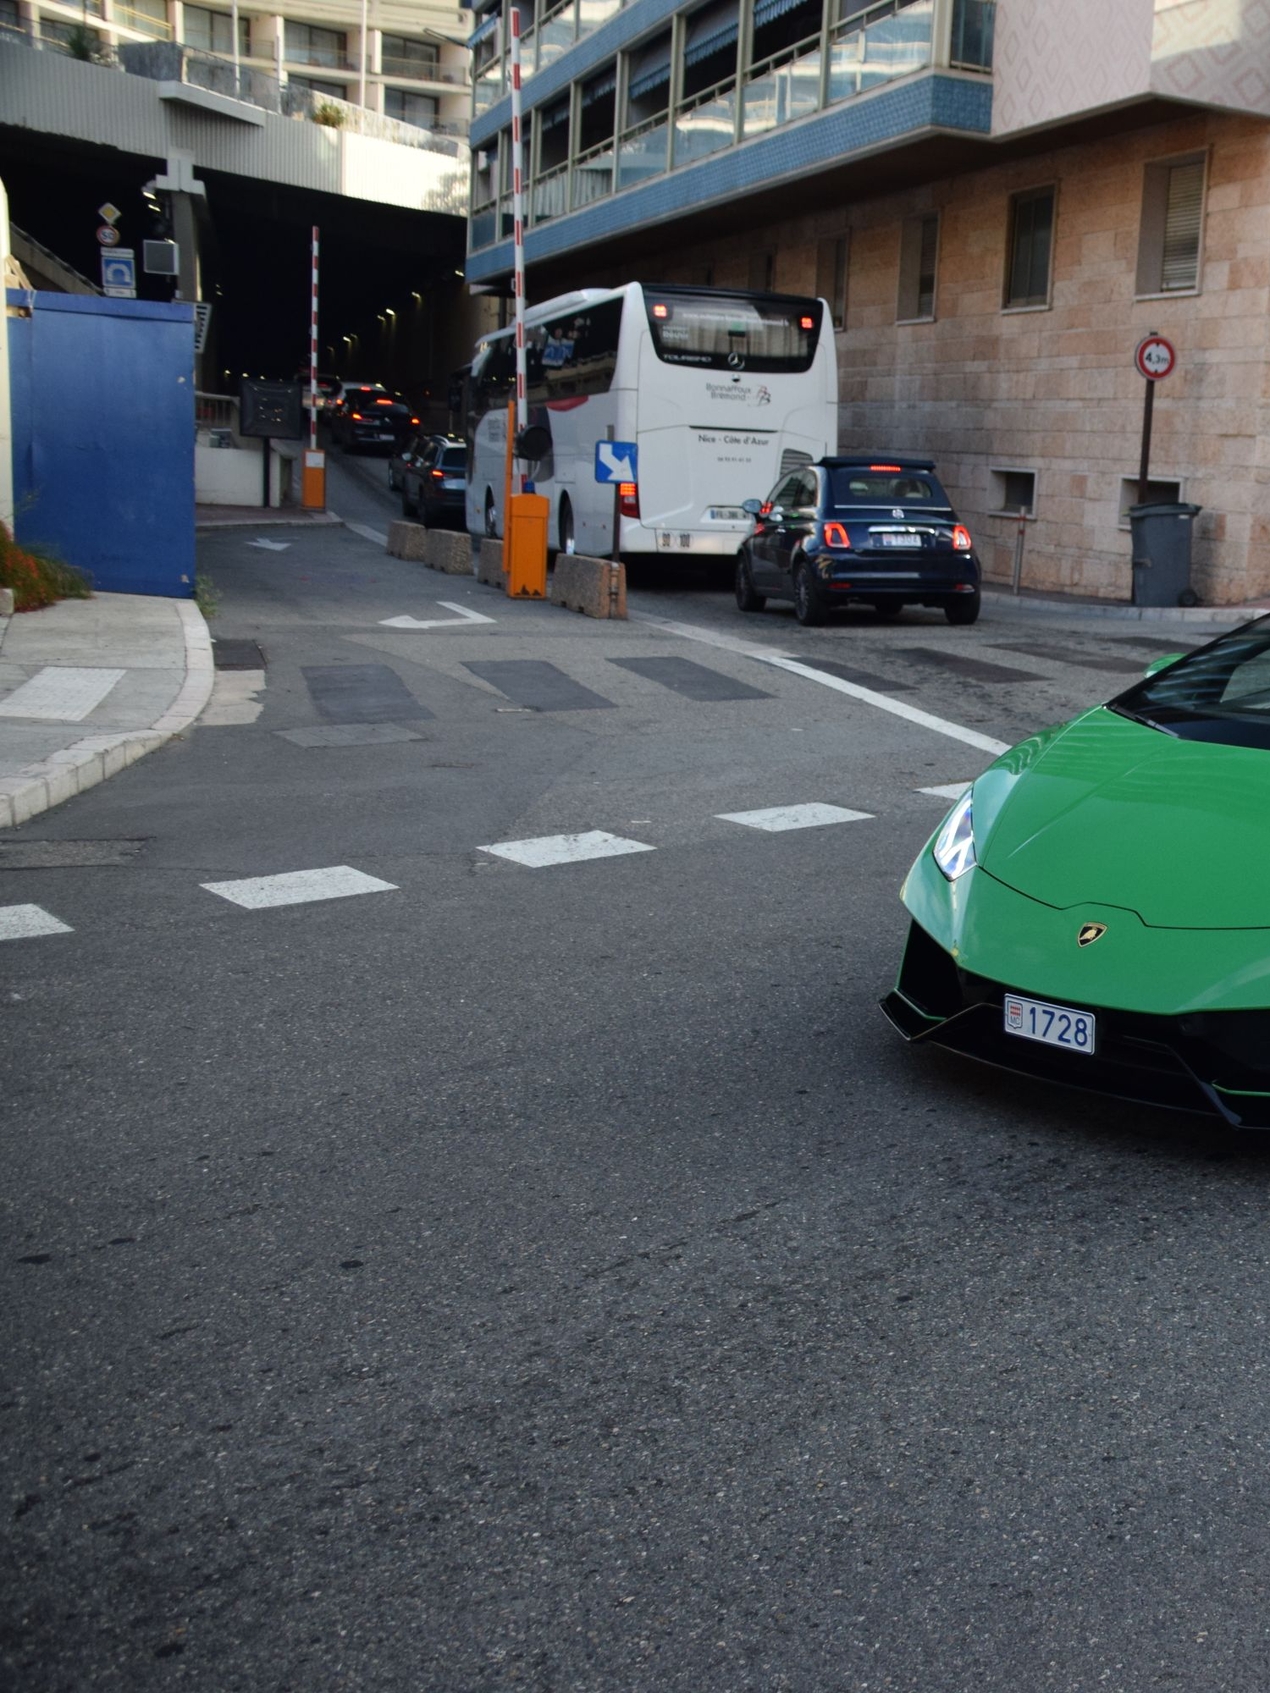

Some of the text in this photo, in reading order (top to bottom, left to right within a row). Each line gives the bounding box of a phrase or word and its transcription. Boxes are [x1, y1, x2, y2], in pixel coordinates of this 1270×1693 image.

[698, 434, 716, 443] Nice
[724, 435, 742, 445] Côte
[1029, 1006, 1088, 1047] 1728
